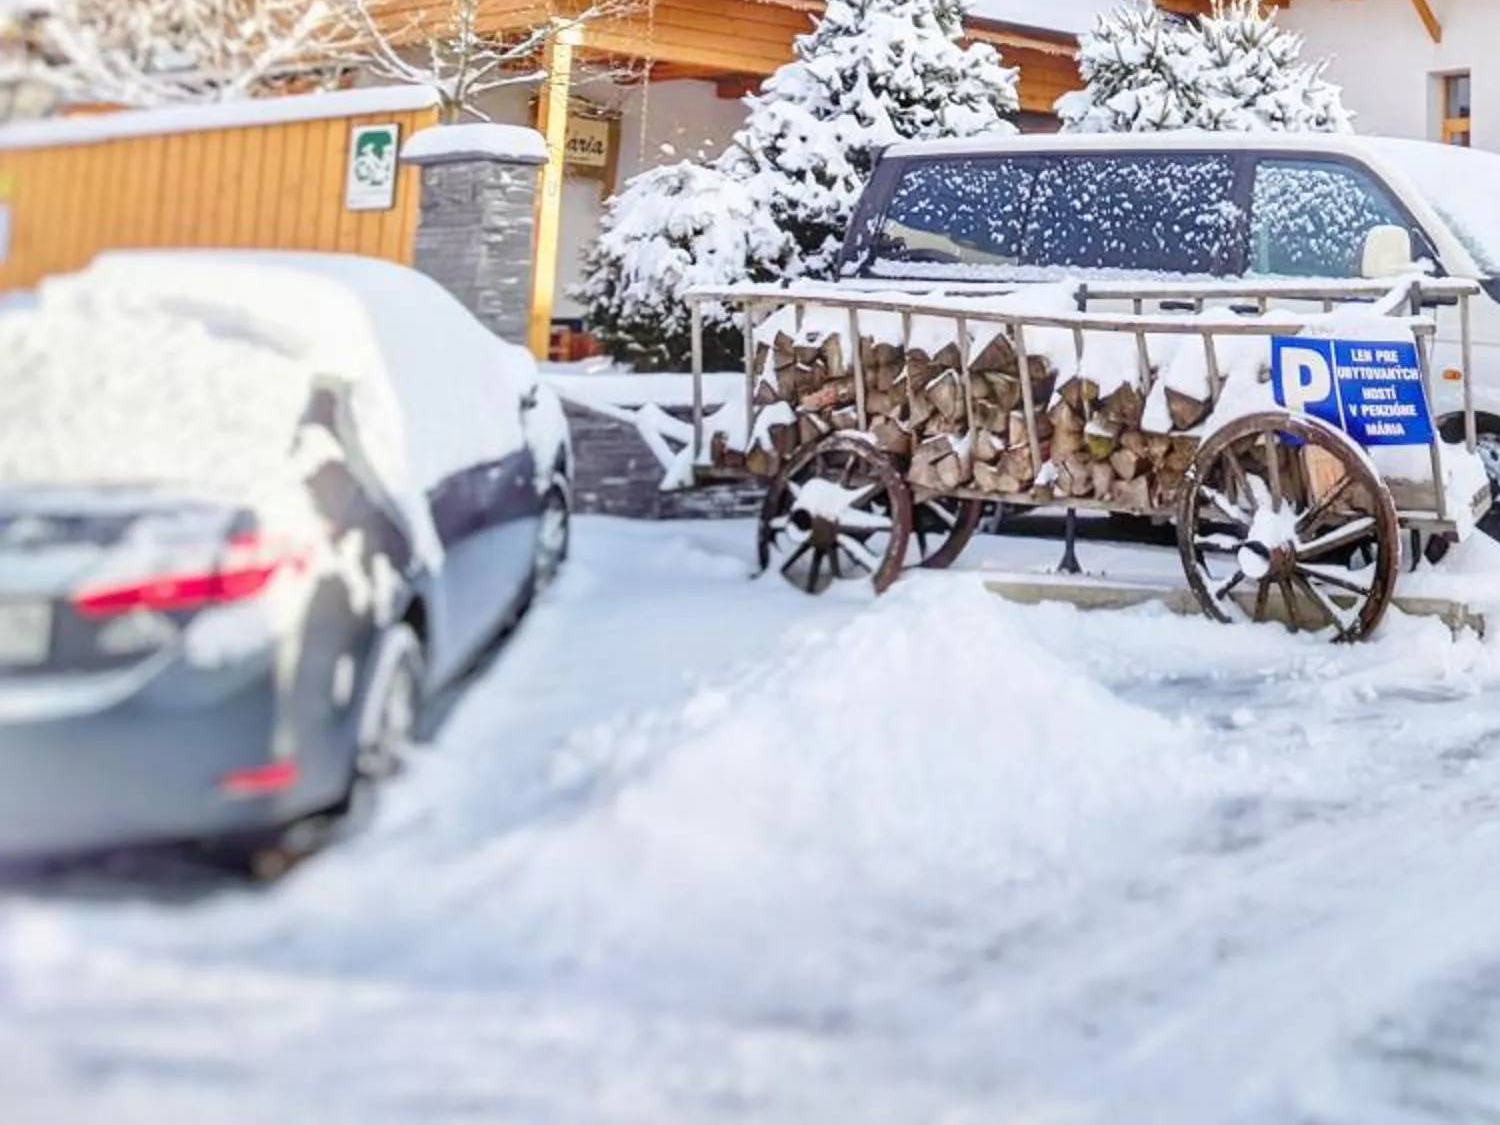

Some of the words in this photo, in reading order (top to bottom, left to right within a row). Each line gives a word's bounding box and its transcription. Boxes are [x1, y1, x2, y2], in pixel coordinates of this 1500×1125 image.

[1350, 348, 1373, 363] LEN
[1375, 349, 1399, 364] PRE
[1280, 346, 1332, 415] P
[1348, 403, 1358, 417] V
[1364, 420, 1406, 436] MÁRIA
